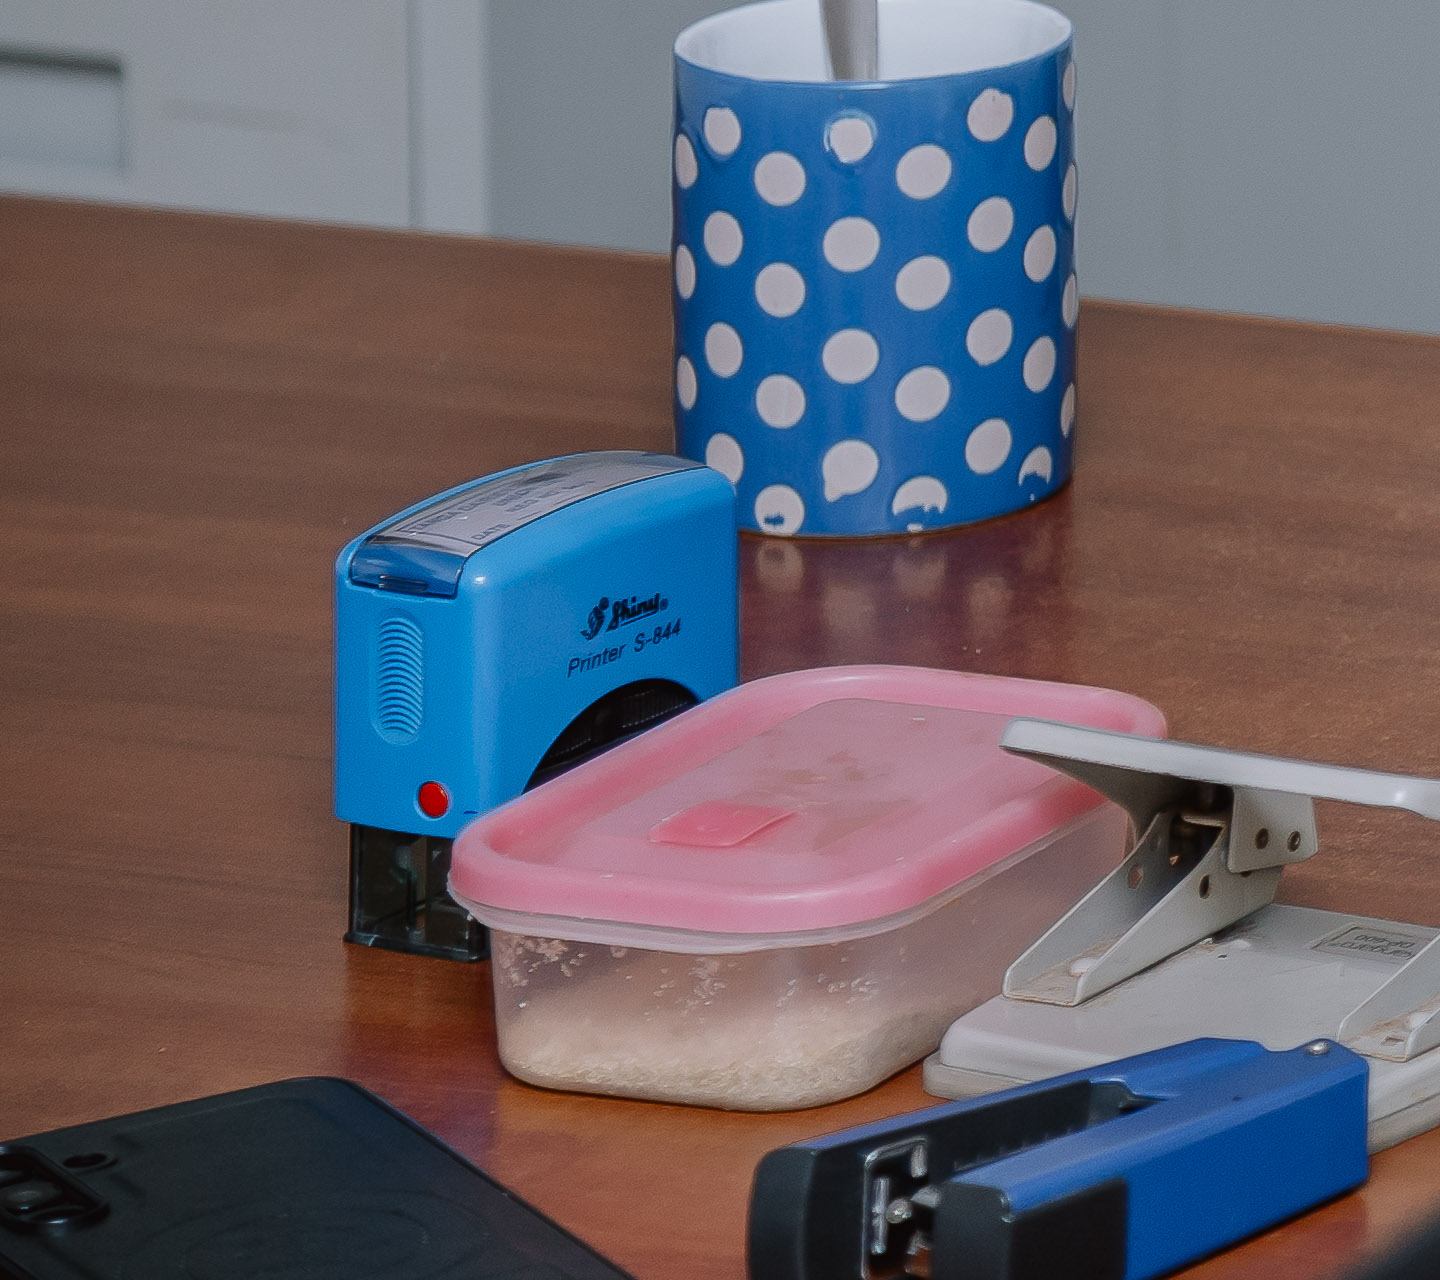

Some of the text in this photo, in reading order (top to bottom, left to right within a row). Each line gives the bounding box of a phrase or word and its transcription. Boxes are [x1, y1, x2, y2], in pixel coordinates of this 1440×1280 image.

[471, 523, 511, 541] DATE
[567, 618, 682, 679] Printer S-844
